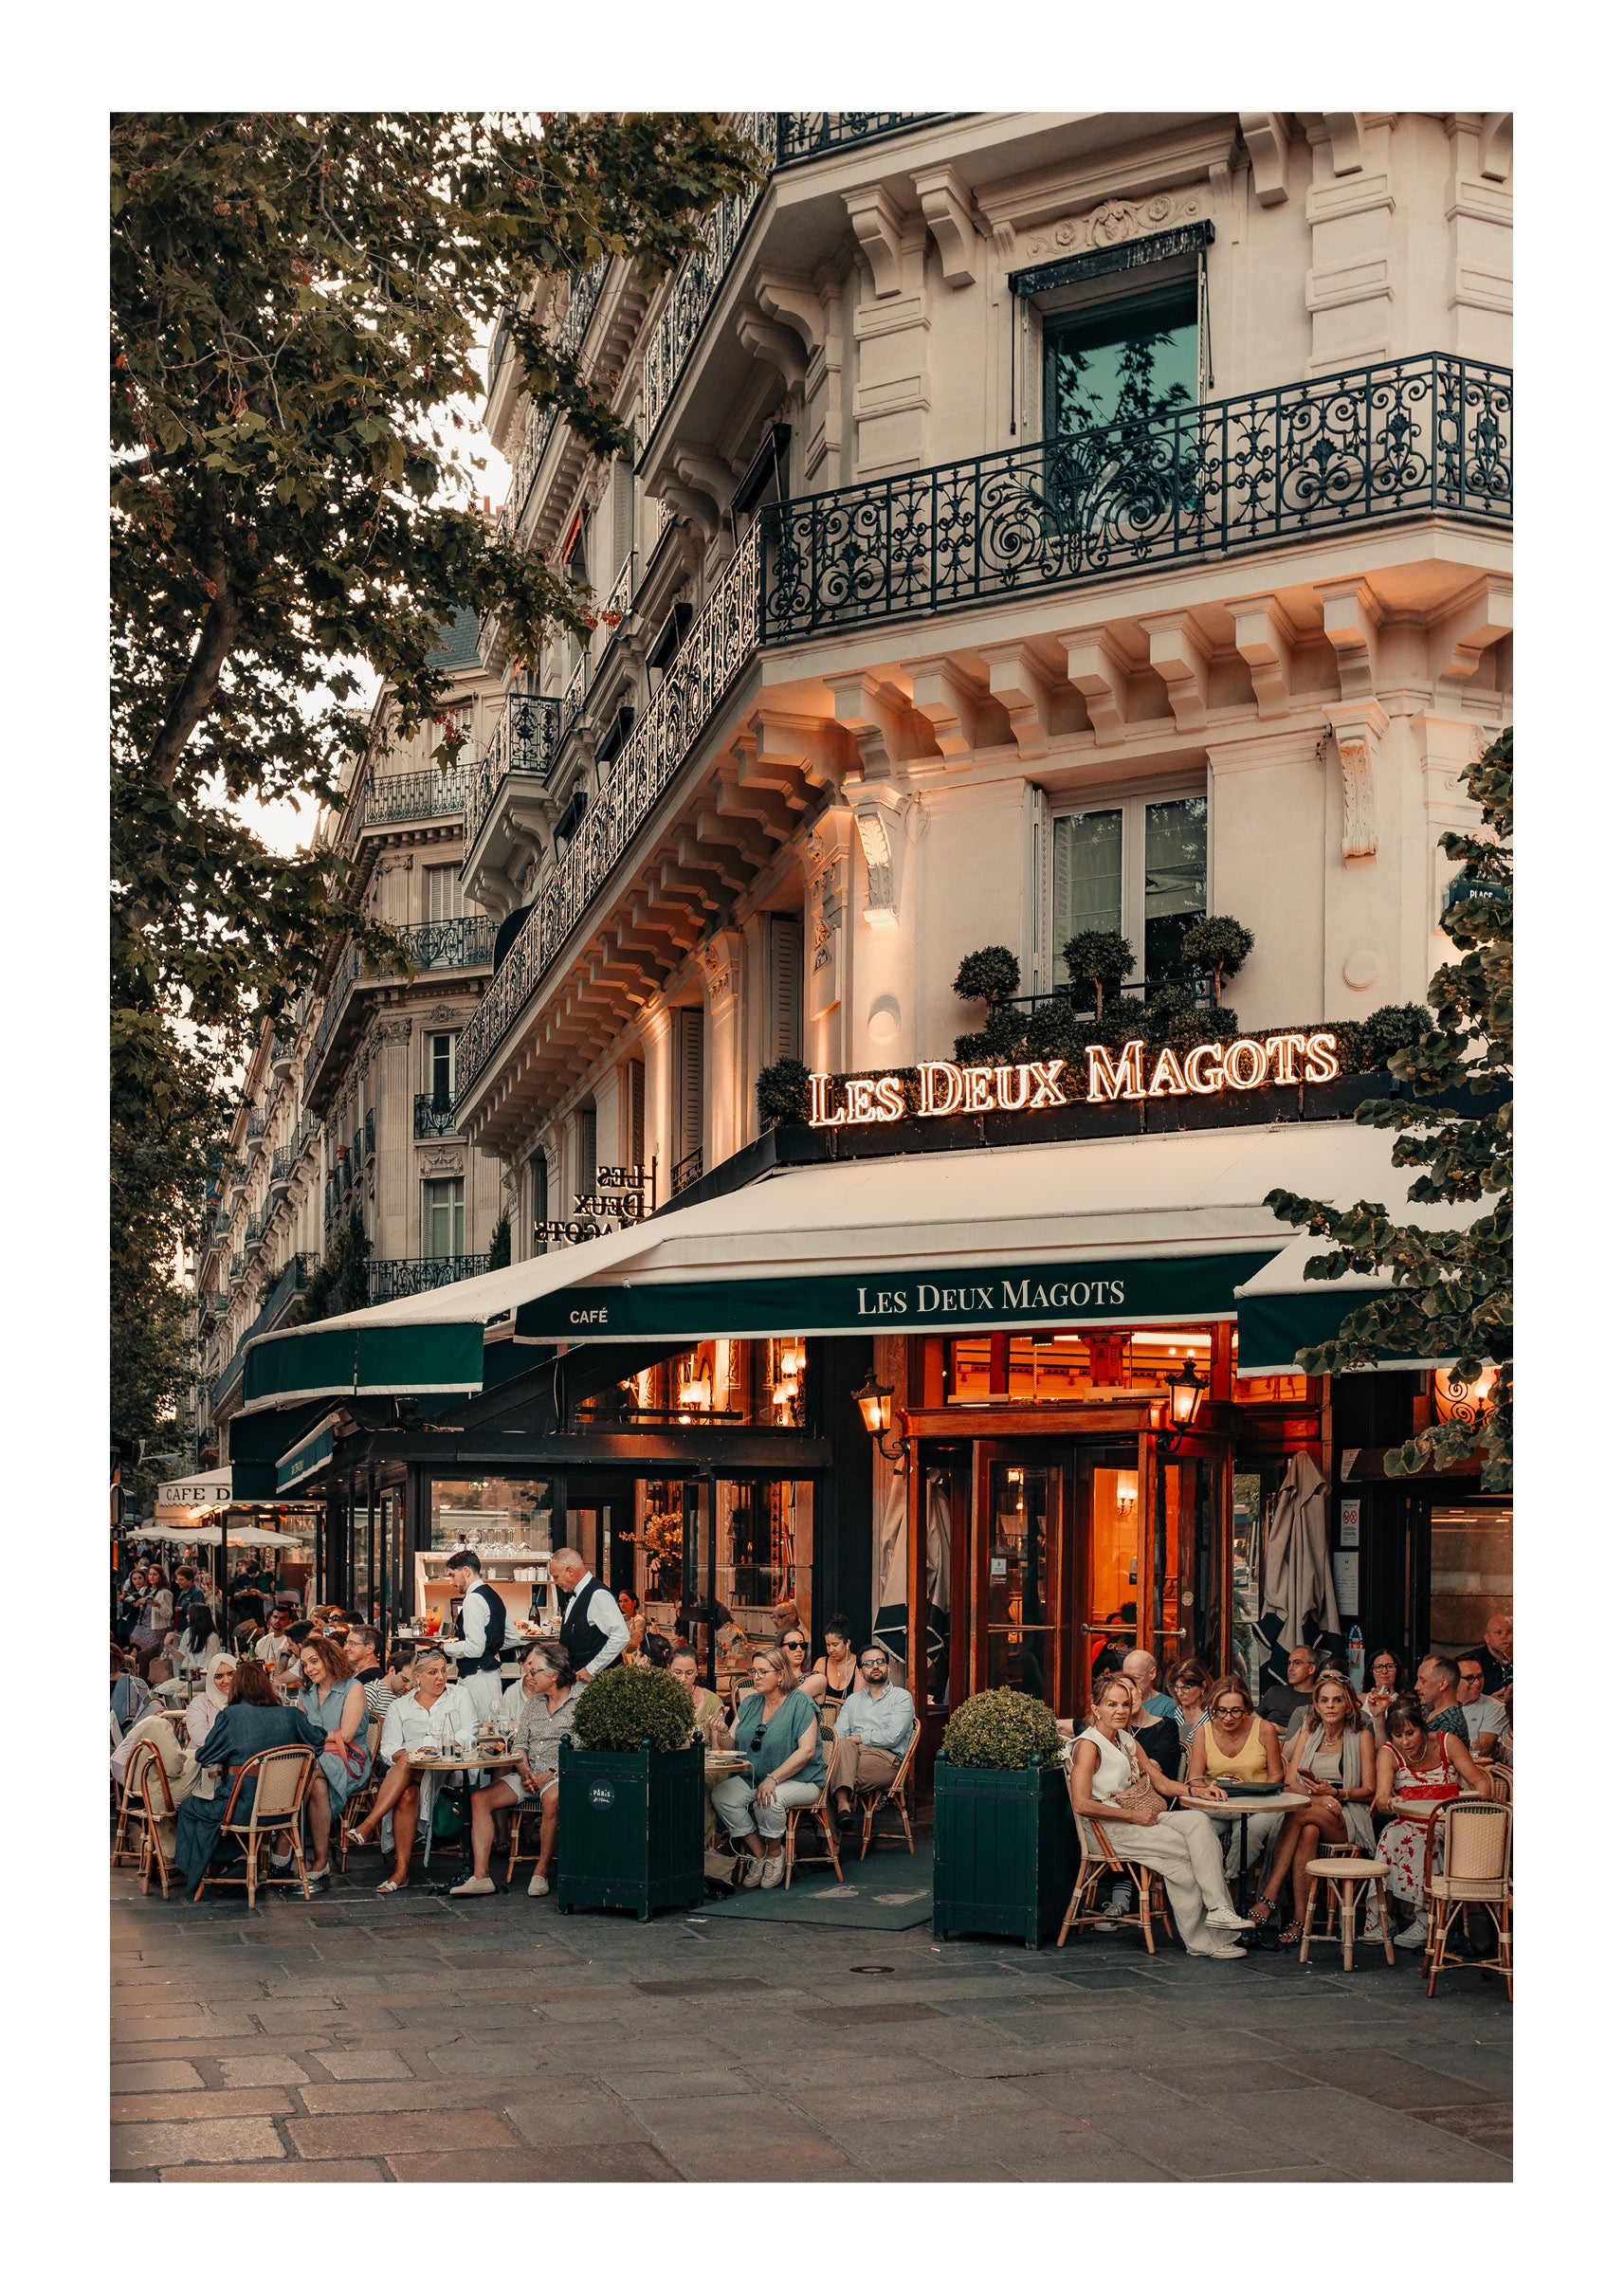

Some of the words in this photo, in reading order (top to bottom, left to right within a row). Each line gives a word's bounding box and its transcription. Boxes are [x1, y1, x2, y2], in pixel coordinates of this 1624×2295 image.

[809, 1073, 906, 1126] LES
[917, 1061, 1067, 1117] DEUX
[1085, 1033, 1341, 1102] MAGOTS
[570, 1307, 608, 1323] CAFÉ
[857, 1287, 907, 1315] LES
[917, 1284, 994, 1313] DEUX
[1001, 1280, 1125, 1309] MAGOTS
